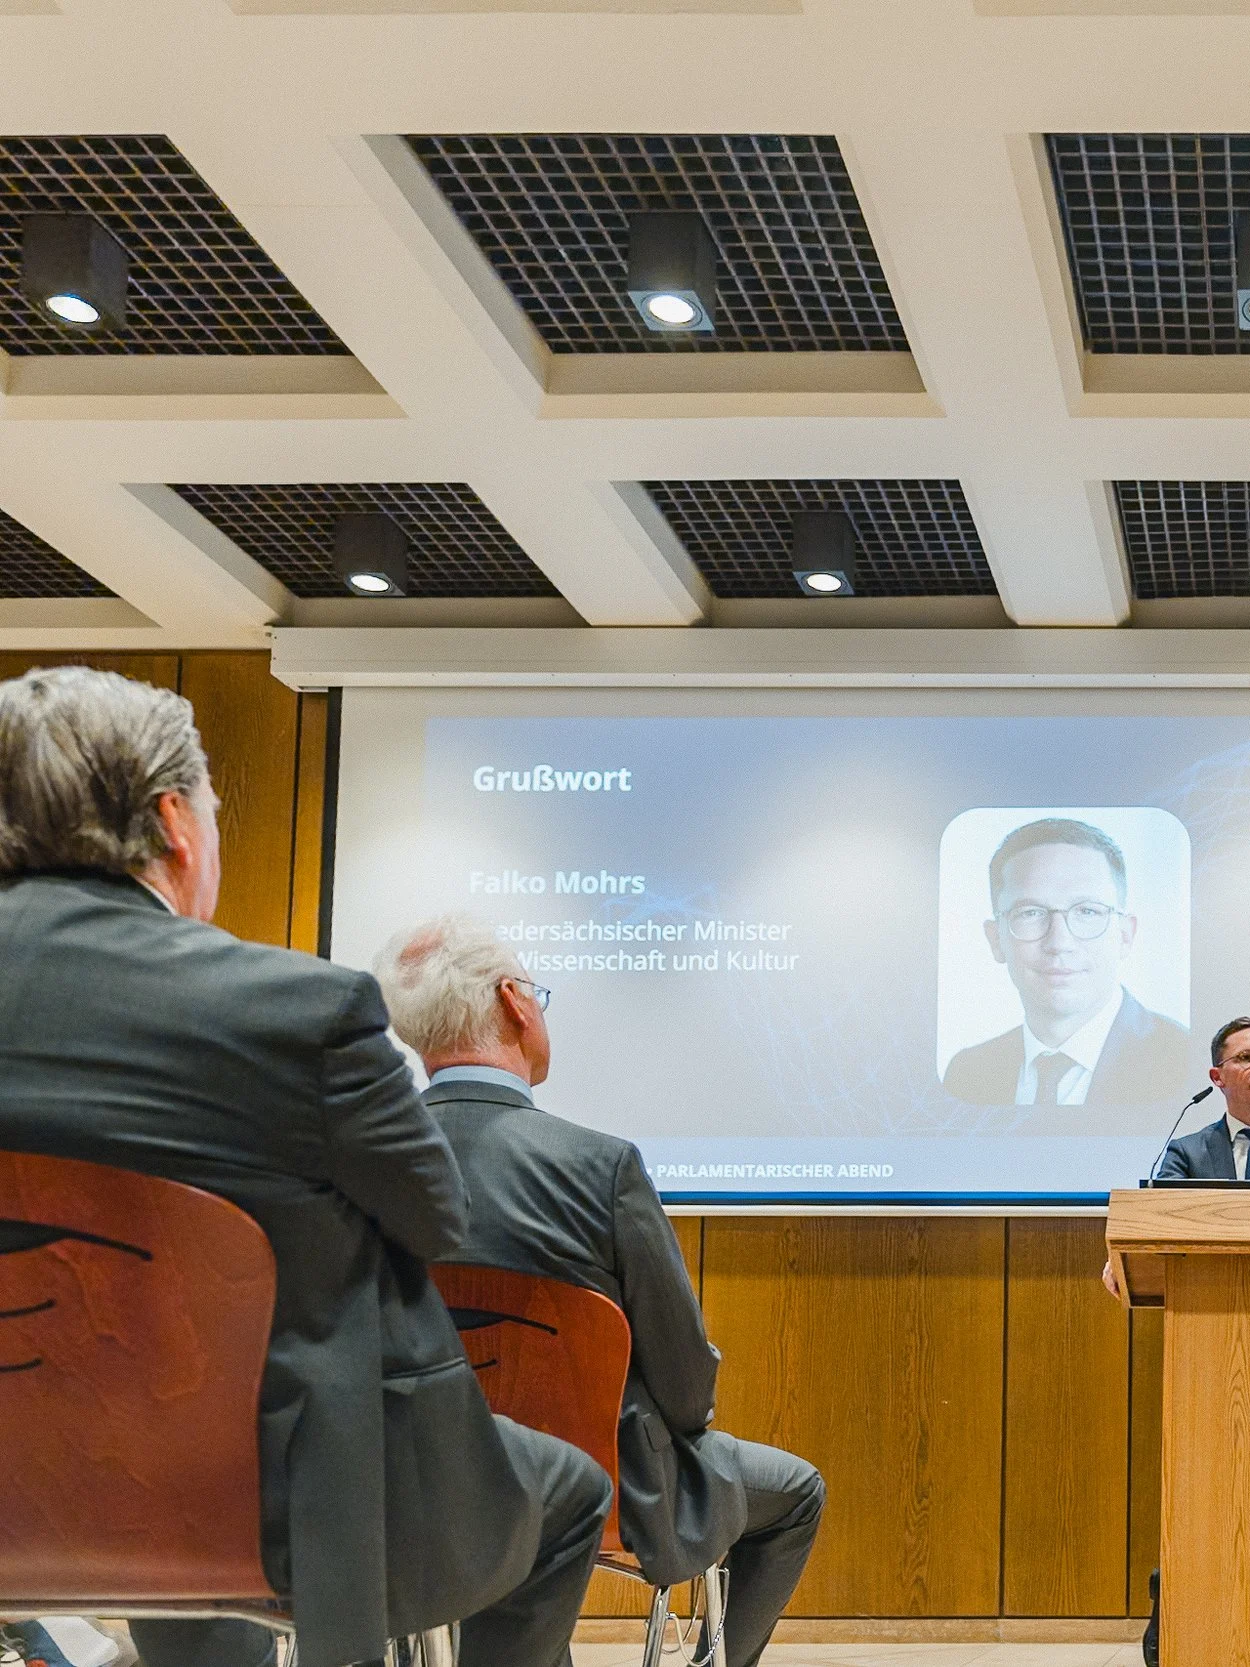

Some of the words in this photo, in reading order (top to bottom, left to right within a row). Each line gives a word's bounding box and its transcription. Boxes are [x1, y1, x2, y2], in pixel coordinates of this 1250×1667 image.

[473, 764, 632, 792] Grußwort
[469, 869, 546, 894] Falko
[555, 869, 646, 894] Mohrs
[491, 919, 687, 942] edersächsischer
[694, 920, 792, 941] Minister
[672, 949, 718, 971] und
[727, 949, 799, 971] Kultur
[656, 1163, 834, 1178] PARLAMENTARISCHER
[837, 1163, 894, 1178] ABEND
